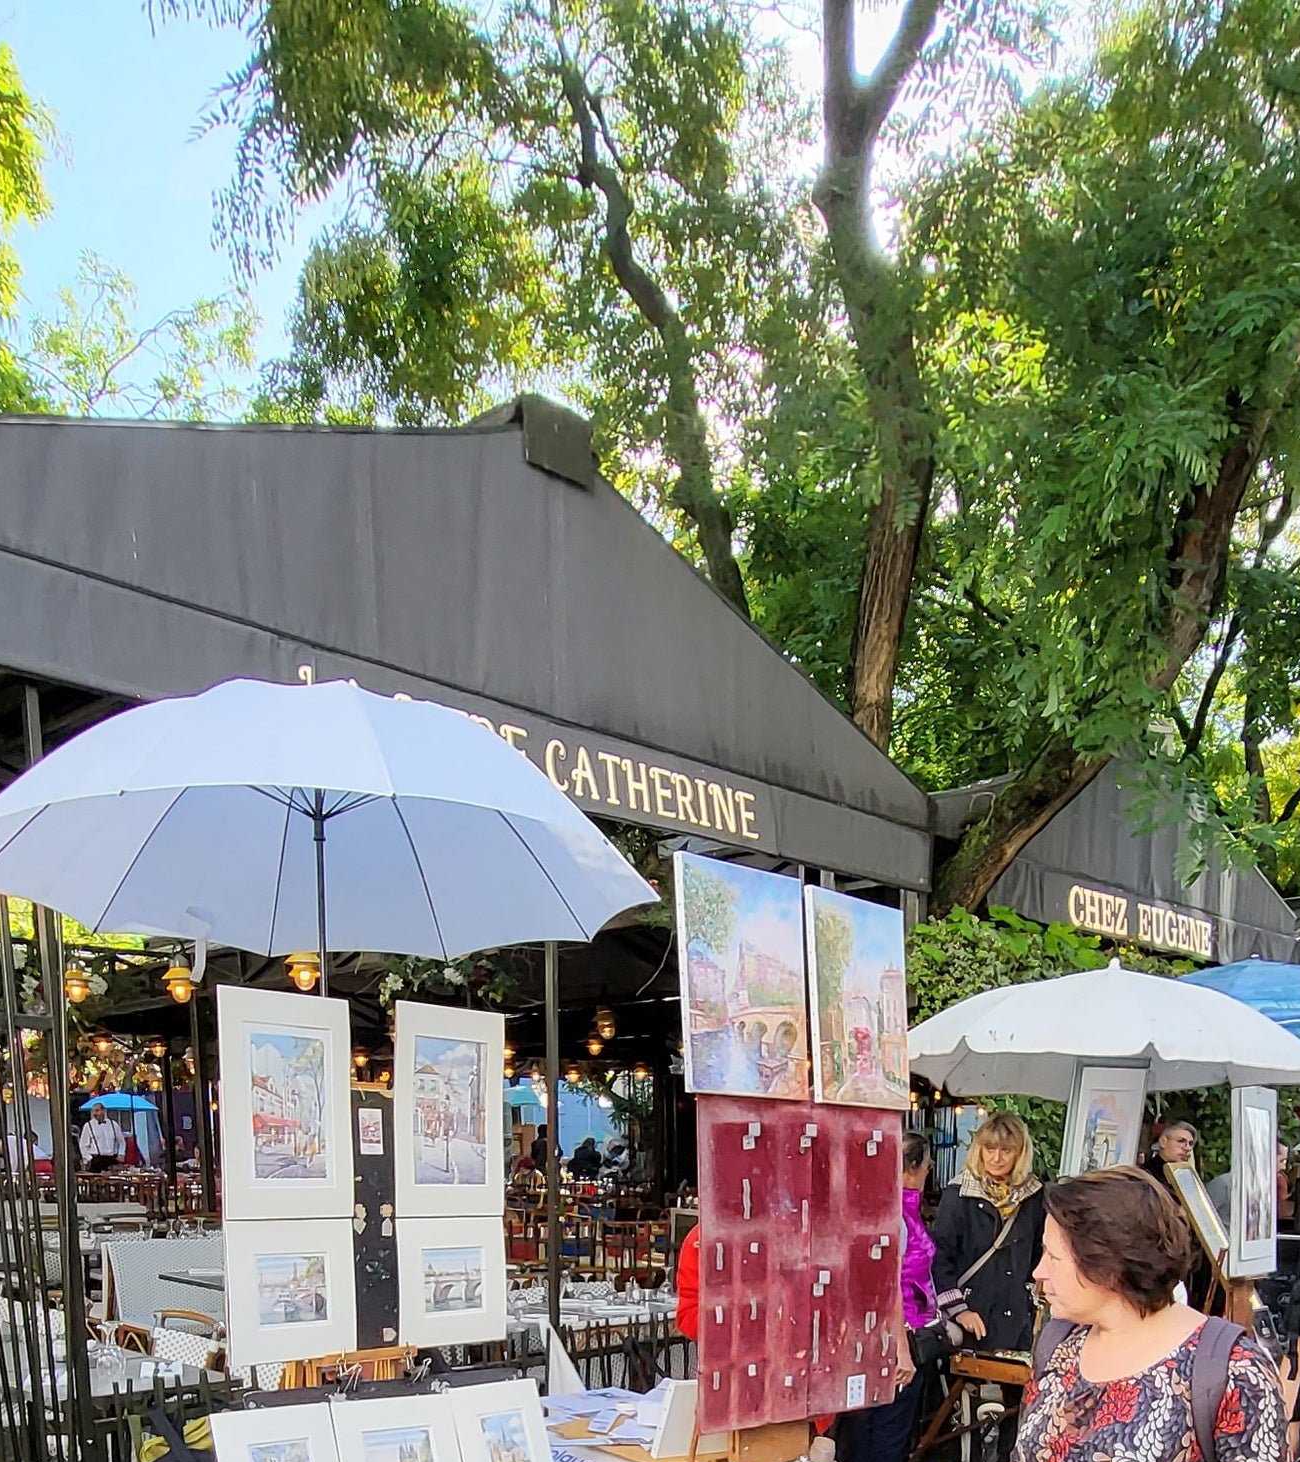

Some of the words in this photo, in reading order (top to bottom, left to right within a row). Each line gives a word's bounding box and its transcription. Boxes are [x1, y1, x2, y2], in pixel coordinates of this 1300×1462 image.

[545, 739, 760, 840] CATHERINE
[1068, 884, 1128, 936] CHEZ
[1137, 902, 1212, 957] EUGENE
